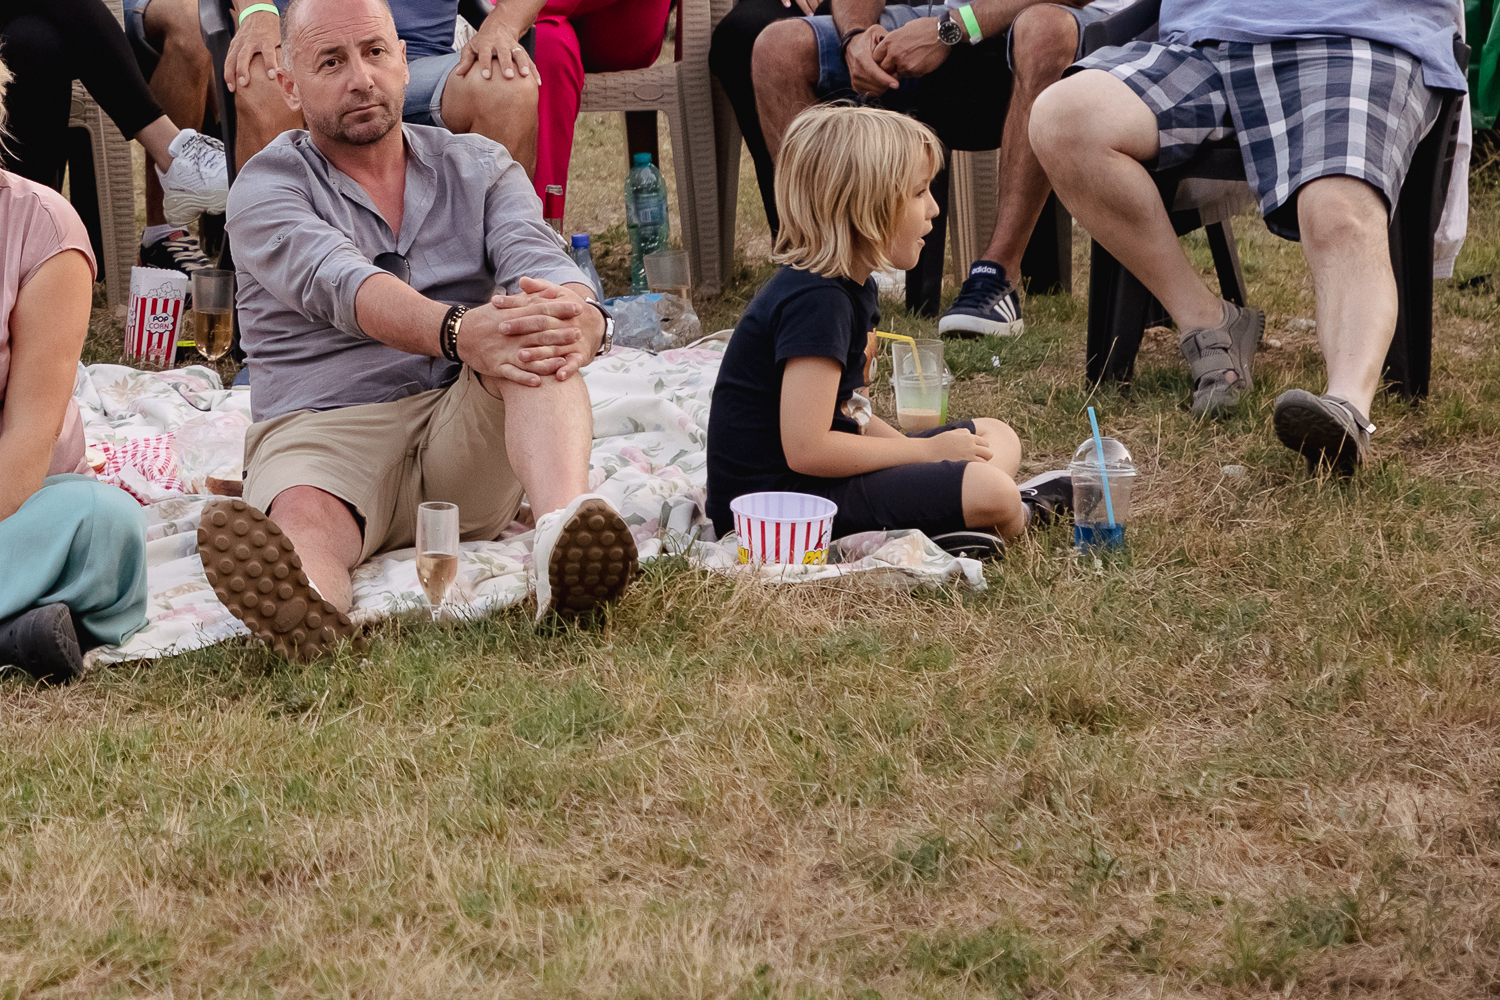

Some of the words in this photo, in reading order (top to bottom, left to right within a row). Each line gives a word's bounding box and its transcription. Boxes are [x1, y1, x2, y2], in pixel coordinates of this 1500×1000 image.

[971, 265, 997, 275] adidas
[152, 315, 169, 323] POP
[148, 322, 169, 330] CORN
